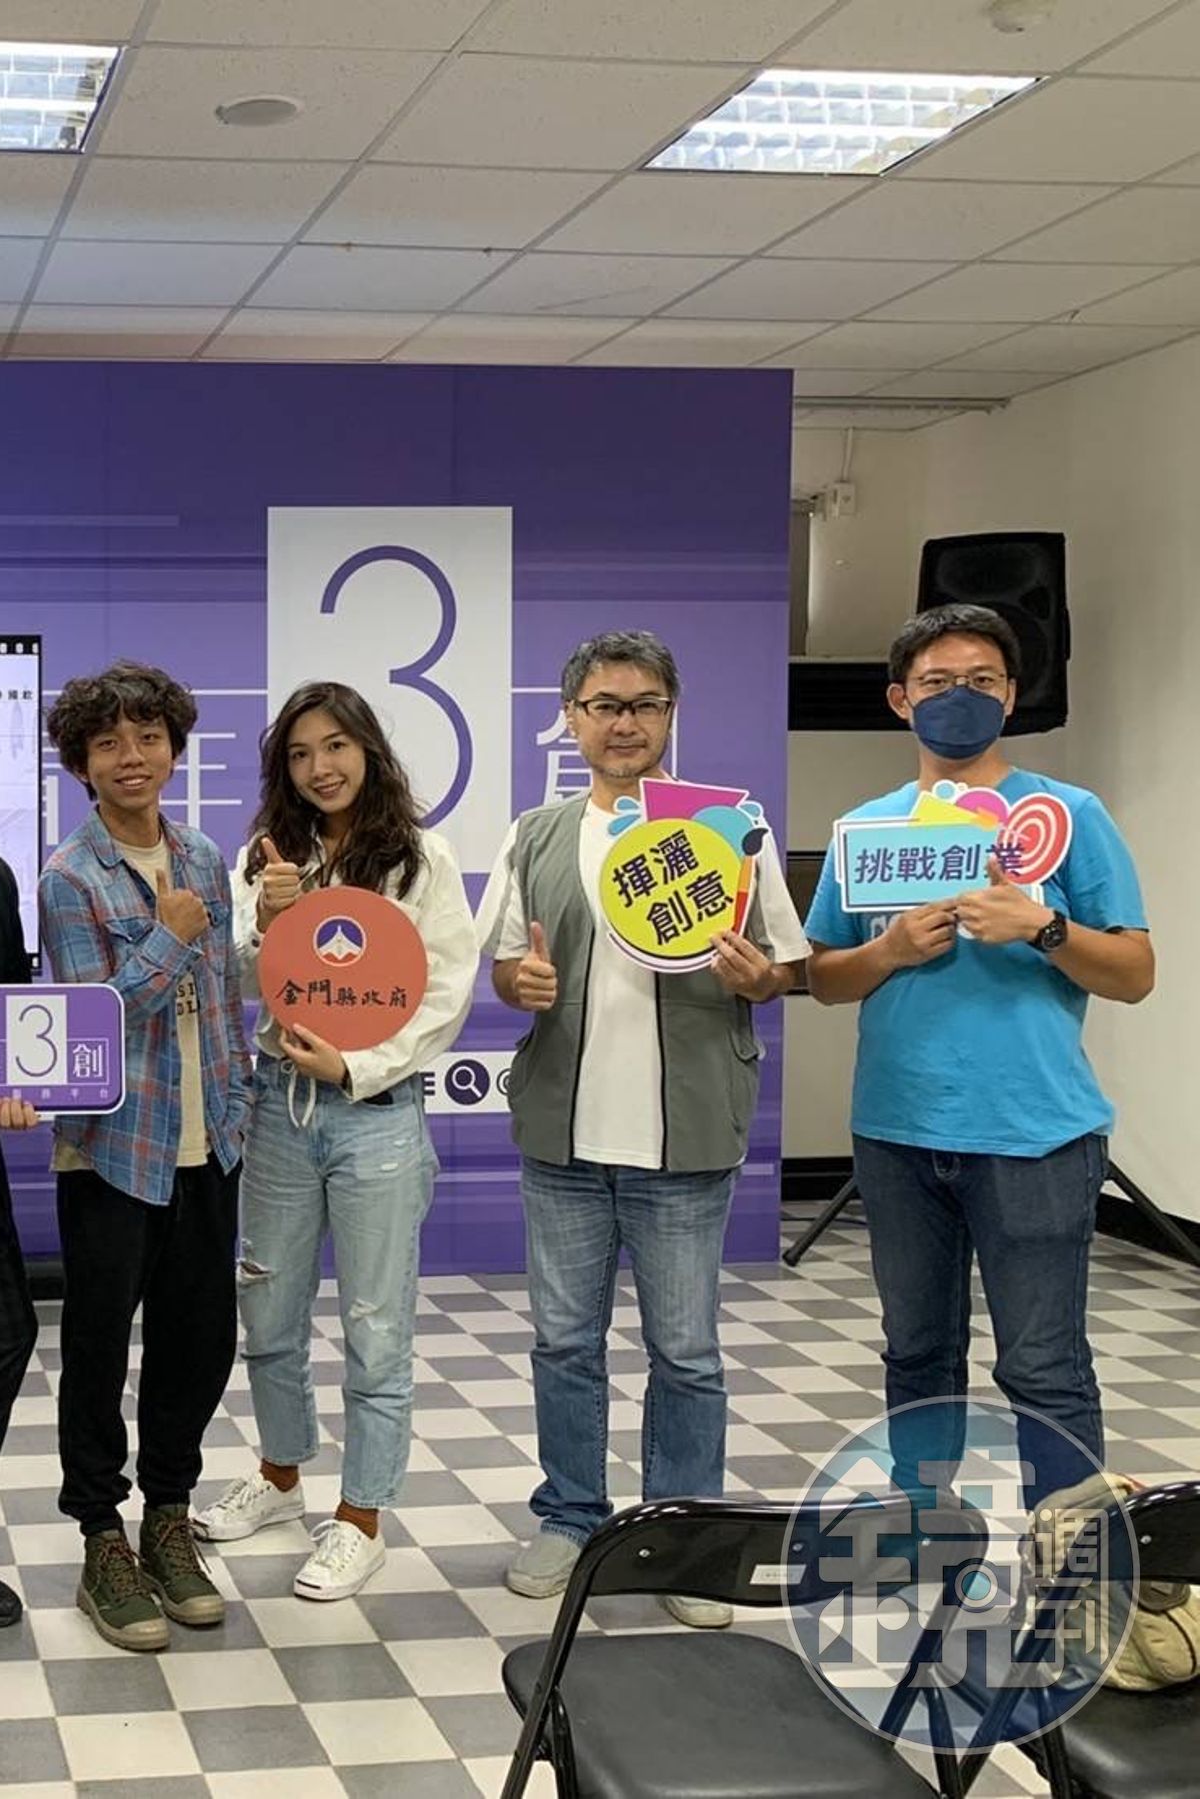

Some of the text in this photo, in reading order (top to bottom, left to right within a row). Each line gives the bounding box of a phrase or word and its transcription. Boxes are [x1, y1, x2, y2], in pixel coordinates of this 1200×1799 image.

[612, 829, 699, 908] 揮灑
[854, 842, 1026, 884] 挑戰創業
[647, 870, 734, 945] 創意
[275, 979, 407, 1009] 金門縣政府
